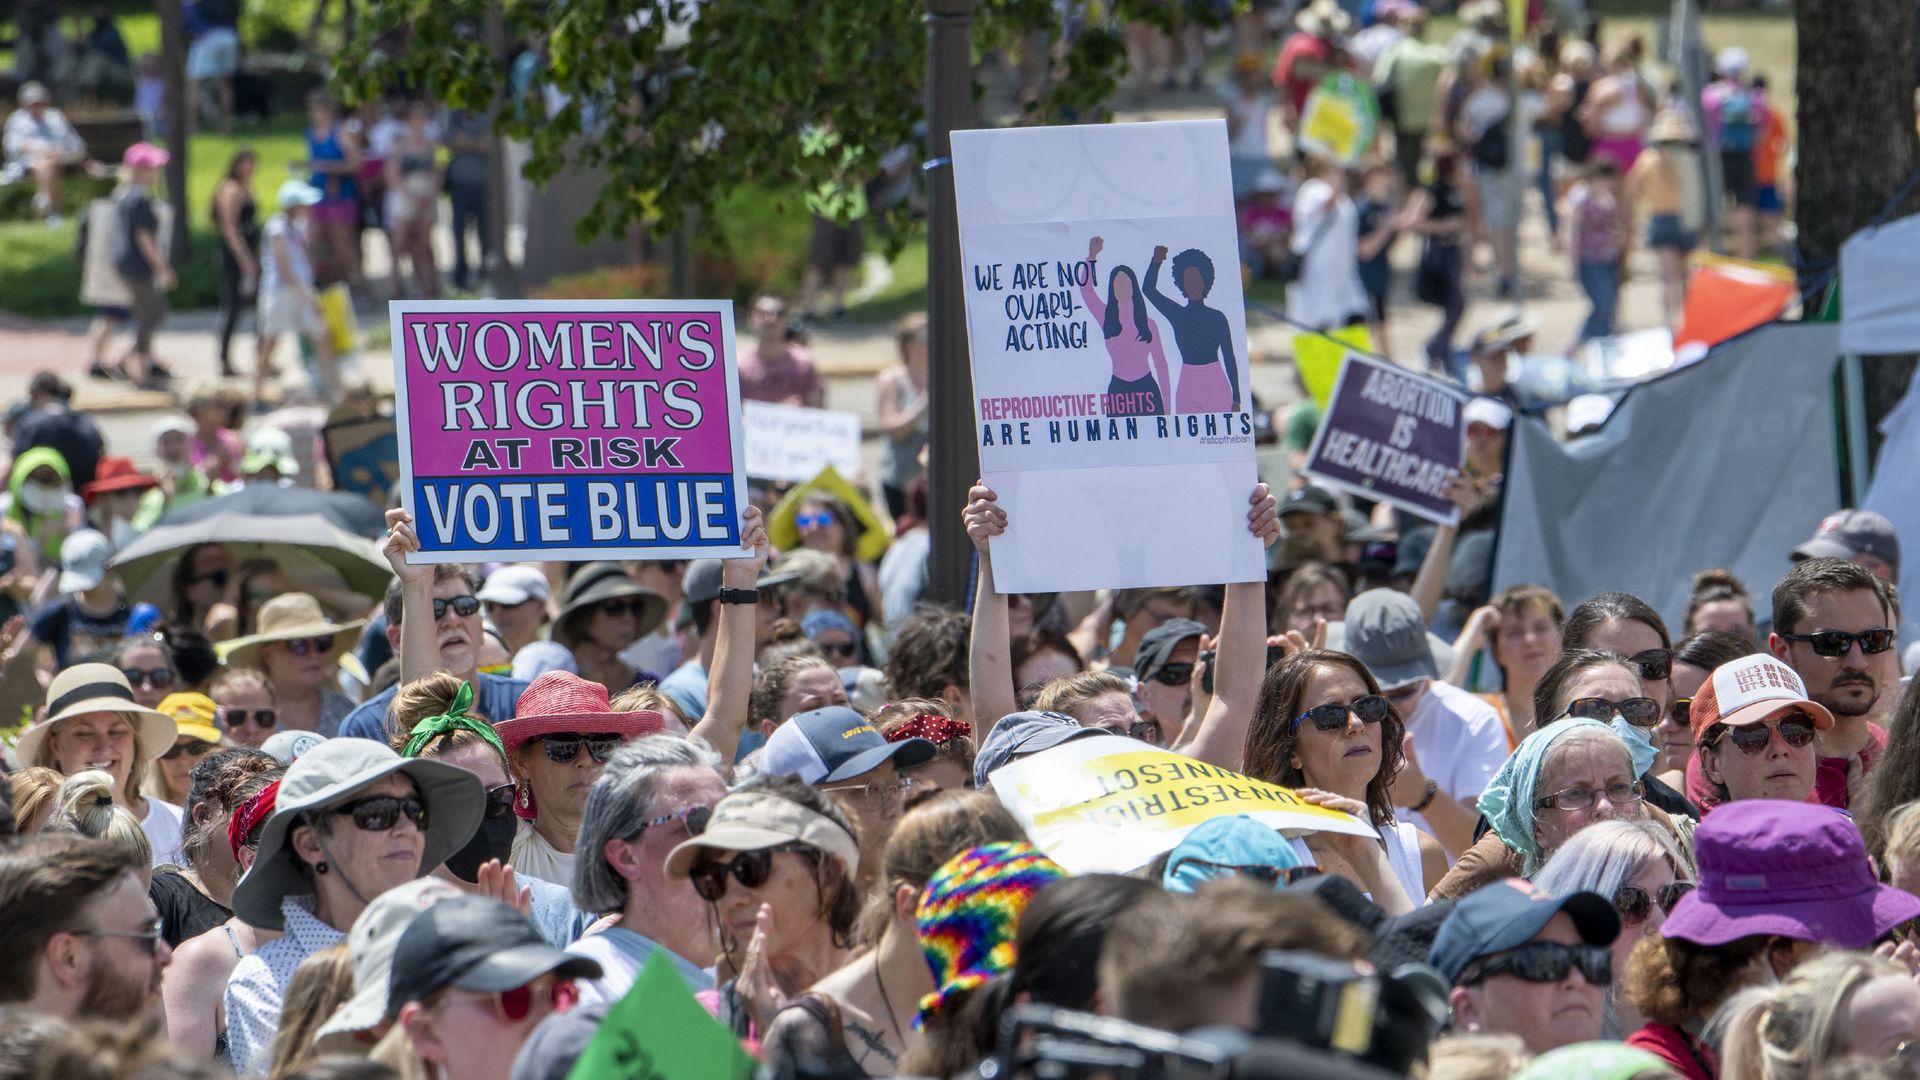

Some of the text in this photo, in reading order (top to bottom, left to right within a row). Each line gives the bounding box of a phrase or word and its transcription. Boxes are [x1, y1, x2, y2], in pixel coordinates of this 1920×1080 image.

[974, 259, 1098, 292] WE ARE NOT
[1004, 289, 1083, 321] OVARY-
[410, 320, 716, 373] WOMEN'S
[1005, 320, 1088, 353] ACTING!
[440, 378, 704, 431] RIGHTS
[979, 391, 1156, 421] REPRODUCTIVE RIGHTS
[1361, 369, 1456, 428] ABORTION
[982, 412, 1252, 446] ARE HUMAN RIGHTS
[1199, 435, 1251, 446] #stoptheban
[1388, 412, 1419, 450] IS
[461, 436, 684, 471] AT RISK
[423, 480, 731, 545] VOTE BLUE
[1740, 681, 1766, 693] LET'S
